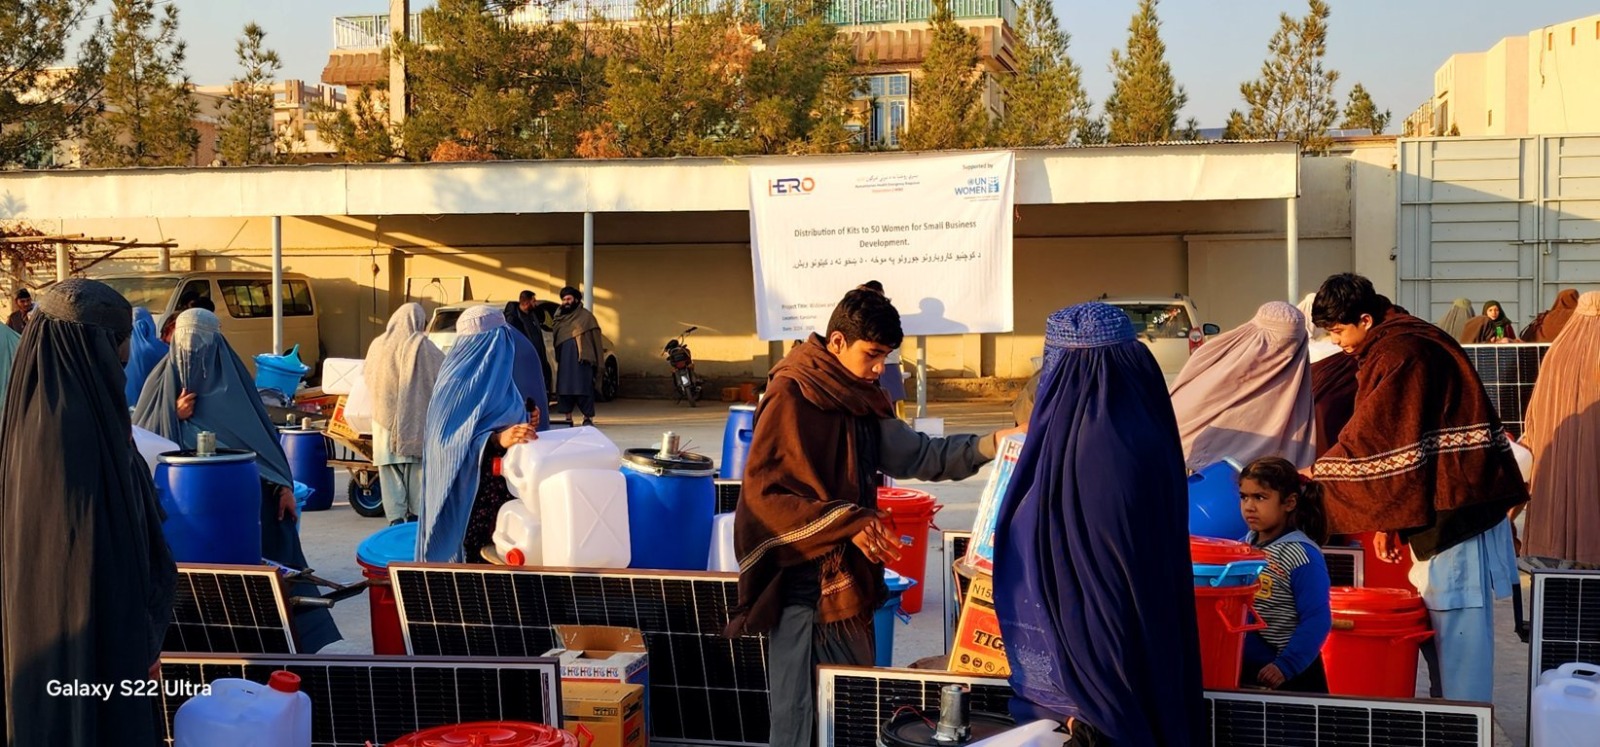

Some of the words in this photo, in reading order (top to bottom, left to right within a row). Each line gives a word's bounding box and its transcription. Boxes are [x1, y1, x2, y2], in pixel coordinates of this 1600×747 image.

[768, 177, 816, 197] HERO
[974, 177, 987, 186] UN
[954, 186, 987, 195] WOMEN
[794, 228, 836, 237] Distribution
[837, 227, 845, 235] of
[846, 226, 860, 235] Kits
[861, 226, 869, 234] to
[870, 225, 880, 233] 50
[881, 224, 910, 233] Women
[911, 222, 922, 231] for
[923, 221, 944, 230] Small
[945, 220, 977, 230] Business
[859, 238, 910, 248] Development.
[972, 583, 993, 598] N15
[973, 629, 1005, 652] TIG
